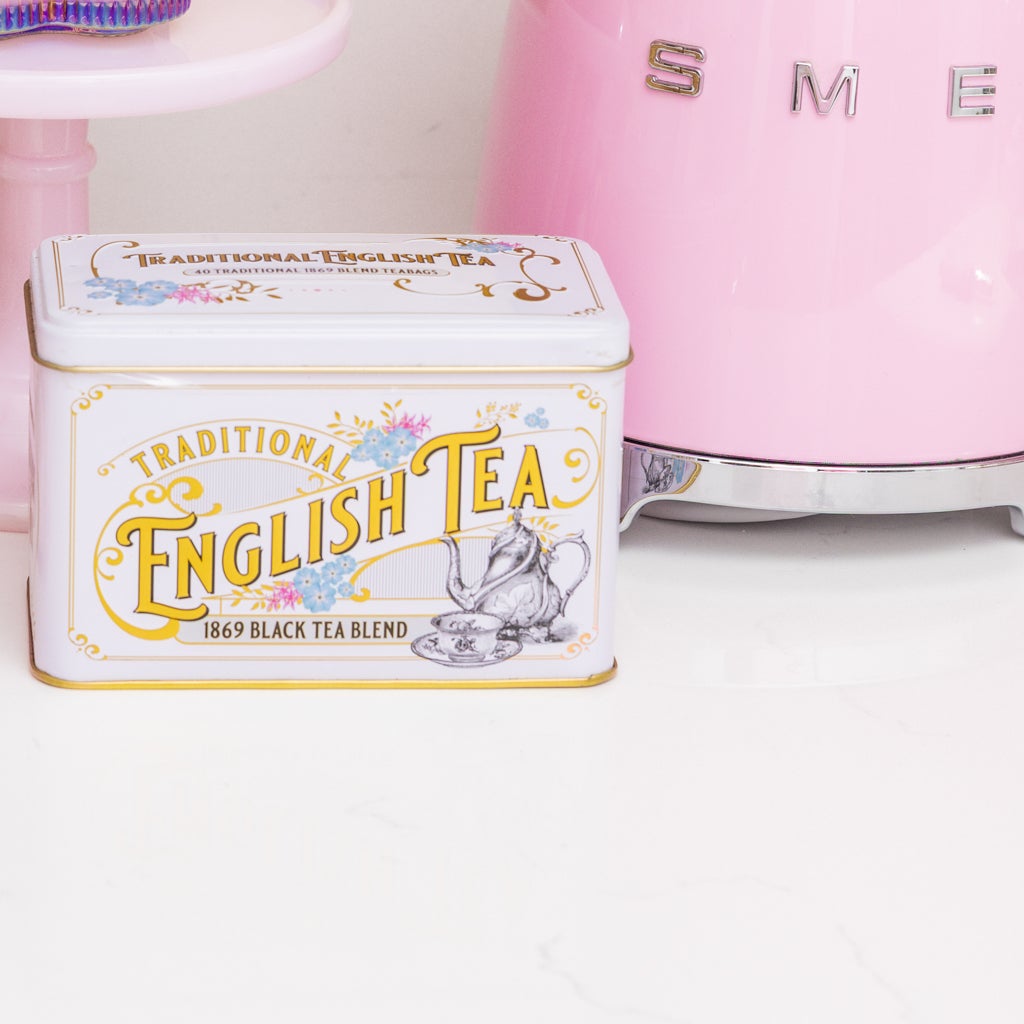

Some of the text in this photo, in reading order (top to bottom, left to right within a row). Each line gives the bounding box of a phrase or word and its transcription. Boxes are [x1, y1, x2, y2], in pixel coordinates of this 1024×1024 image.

[122, 250, 496, 268] TRADITIONAL ENGLISH TEA
[131, 426, 351, 481] TRADITIONAL
[115, 424, 550, 621] ENGLISH TEA
[204, 621, 408, 639] 1869 BLACK TEA BLEND
